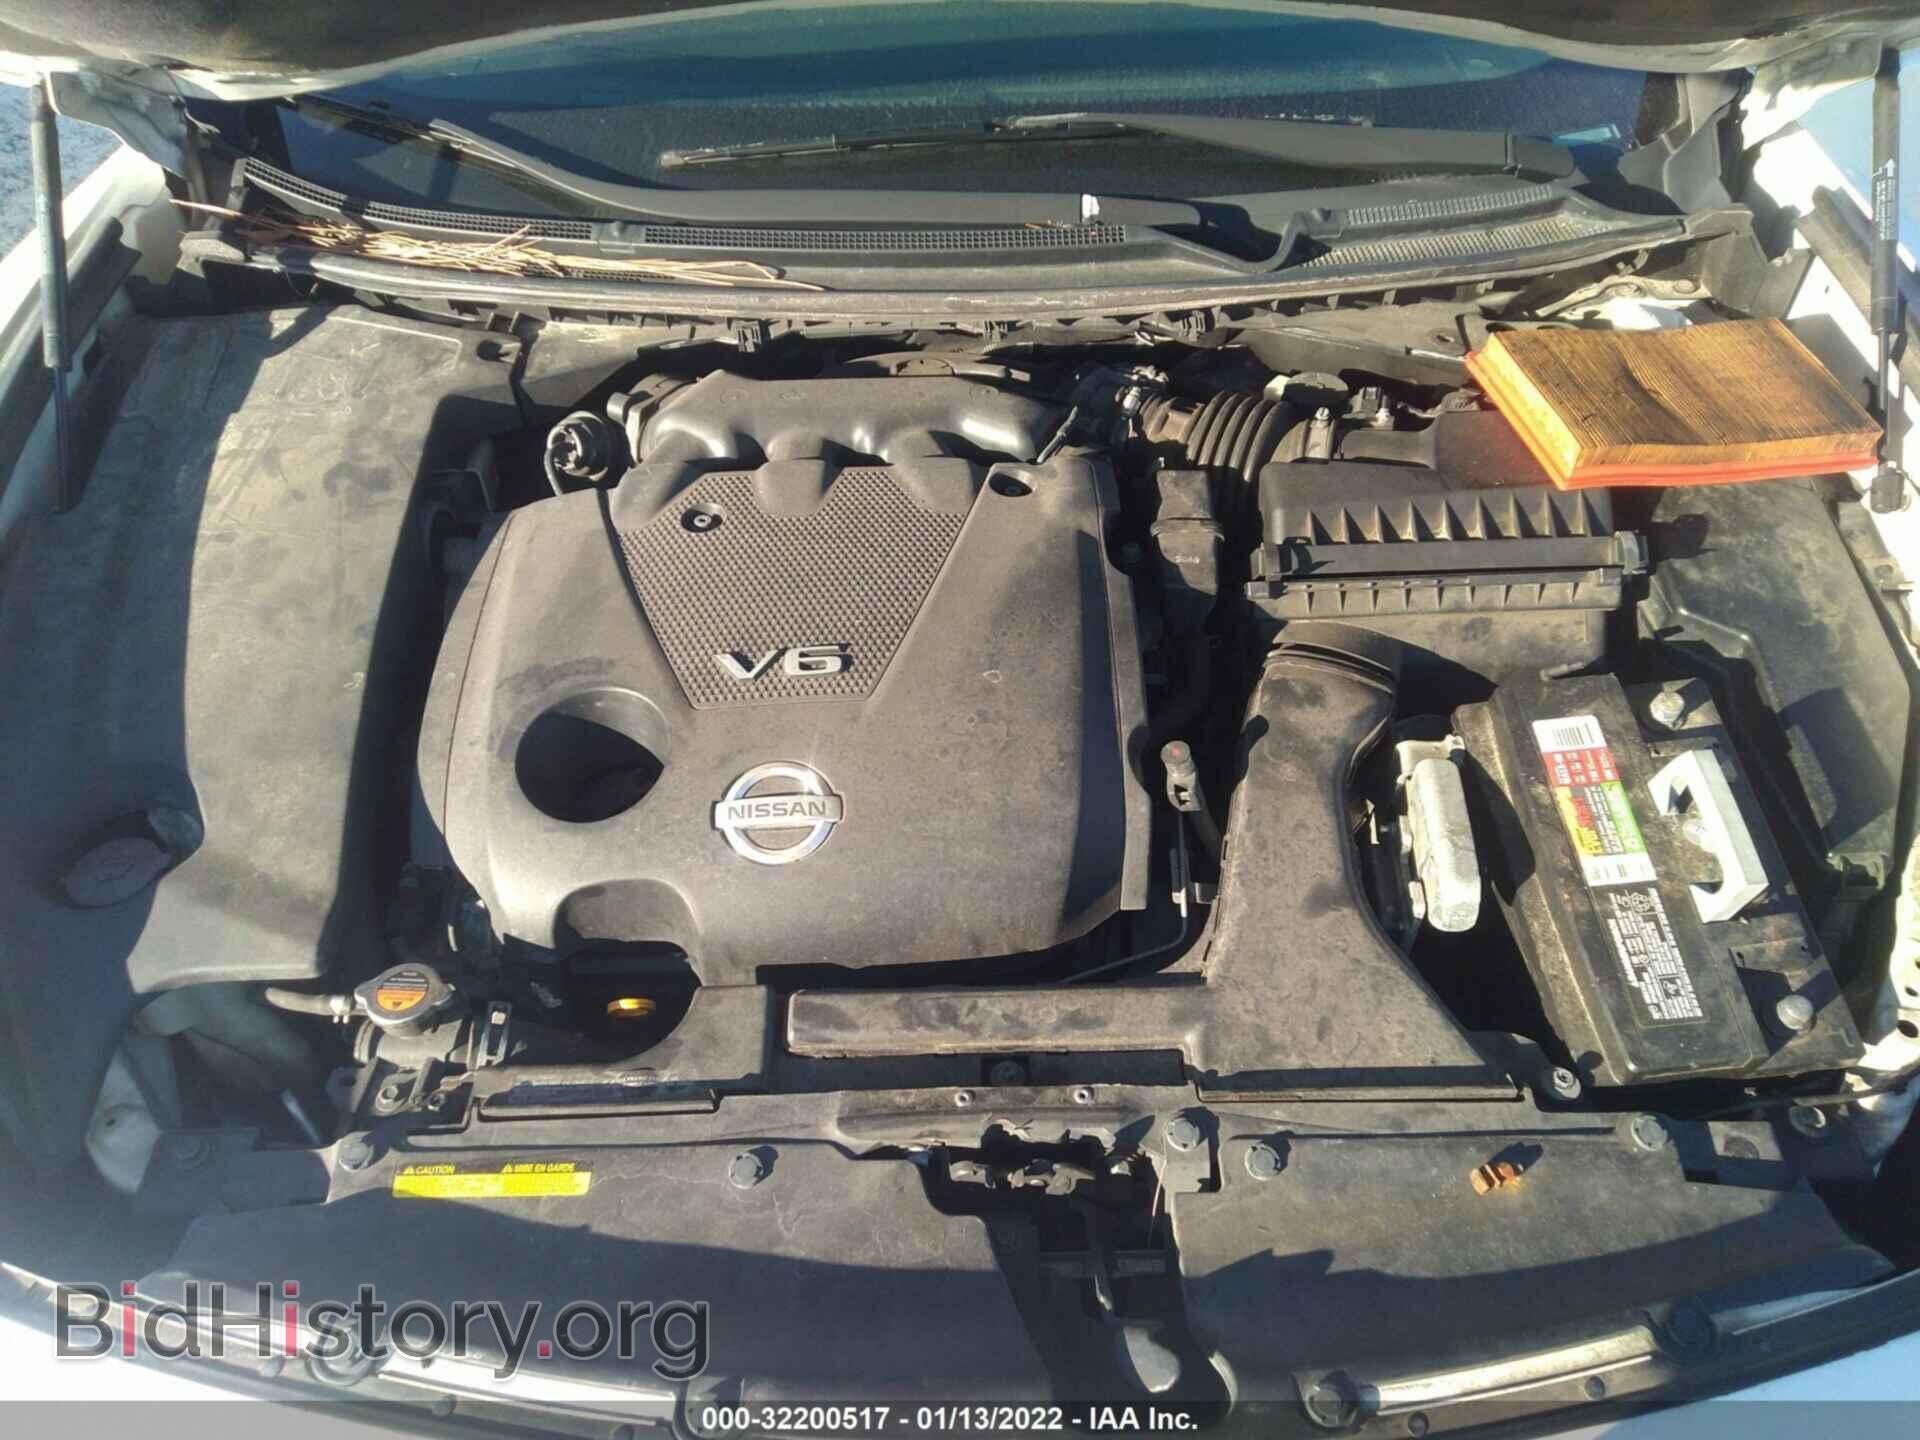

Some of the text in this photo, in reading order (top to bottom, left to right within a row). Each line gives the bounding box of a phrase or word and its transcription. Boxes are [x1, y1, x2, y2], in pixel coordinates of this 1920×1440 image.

[712, 642, 855, 680] V6
[727, 799, 827, 821] NISSAN
[415, 1164, 456, 1175] CAUTION
